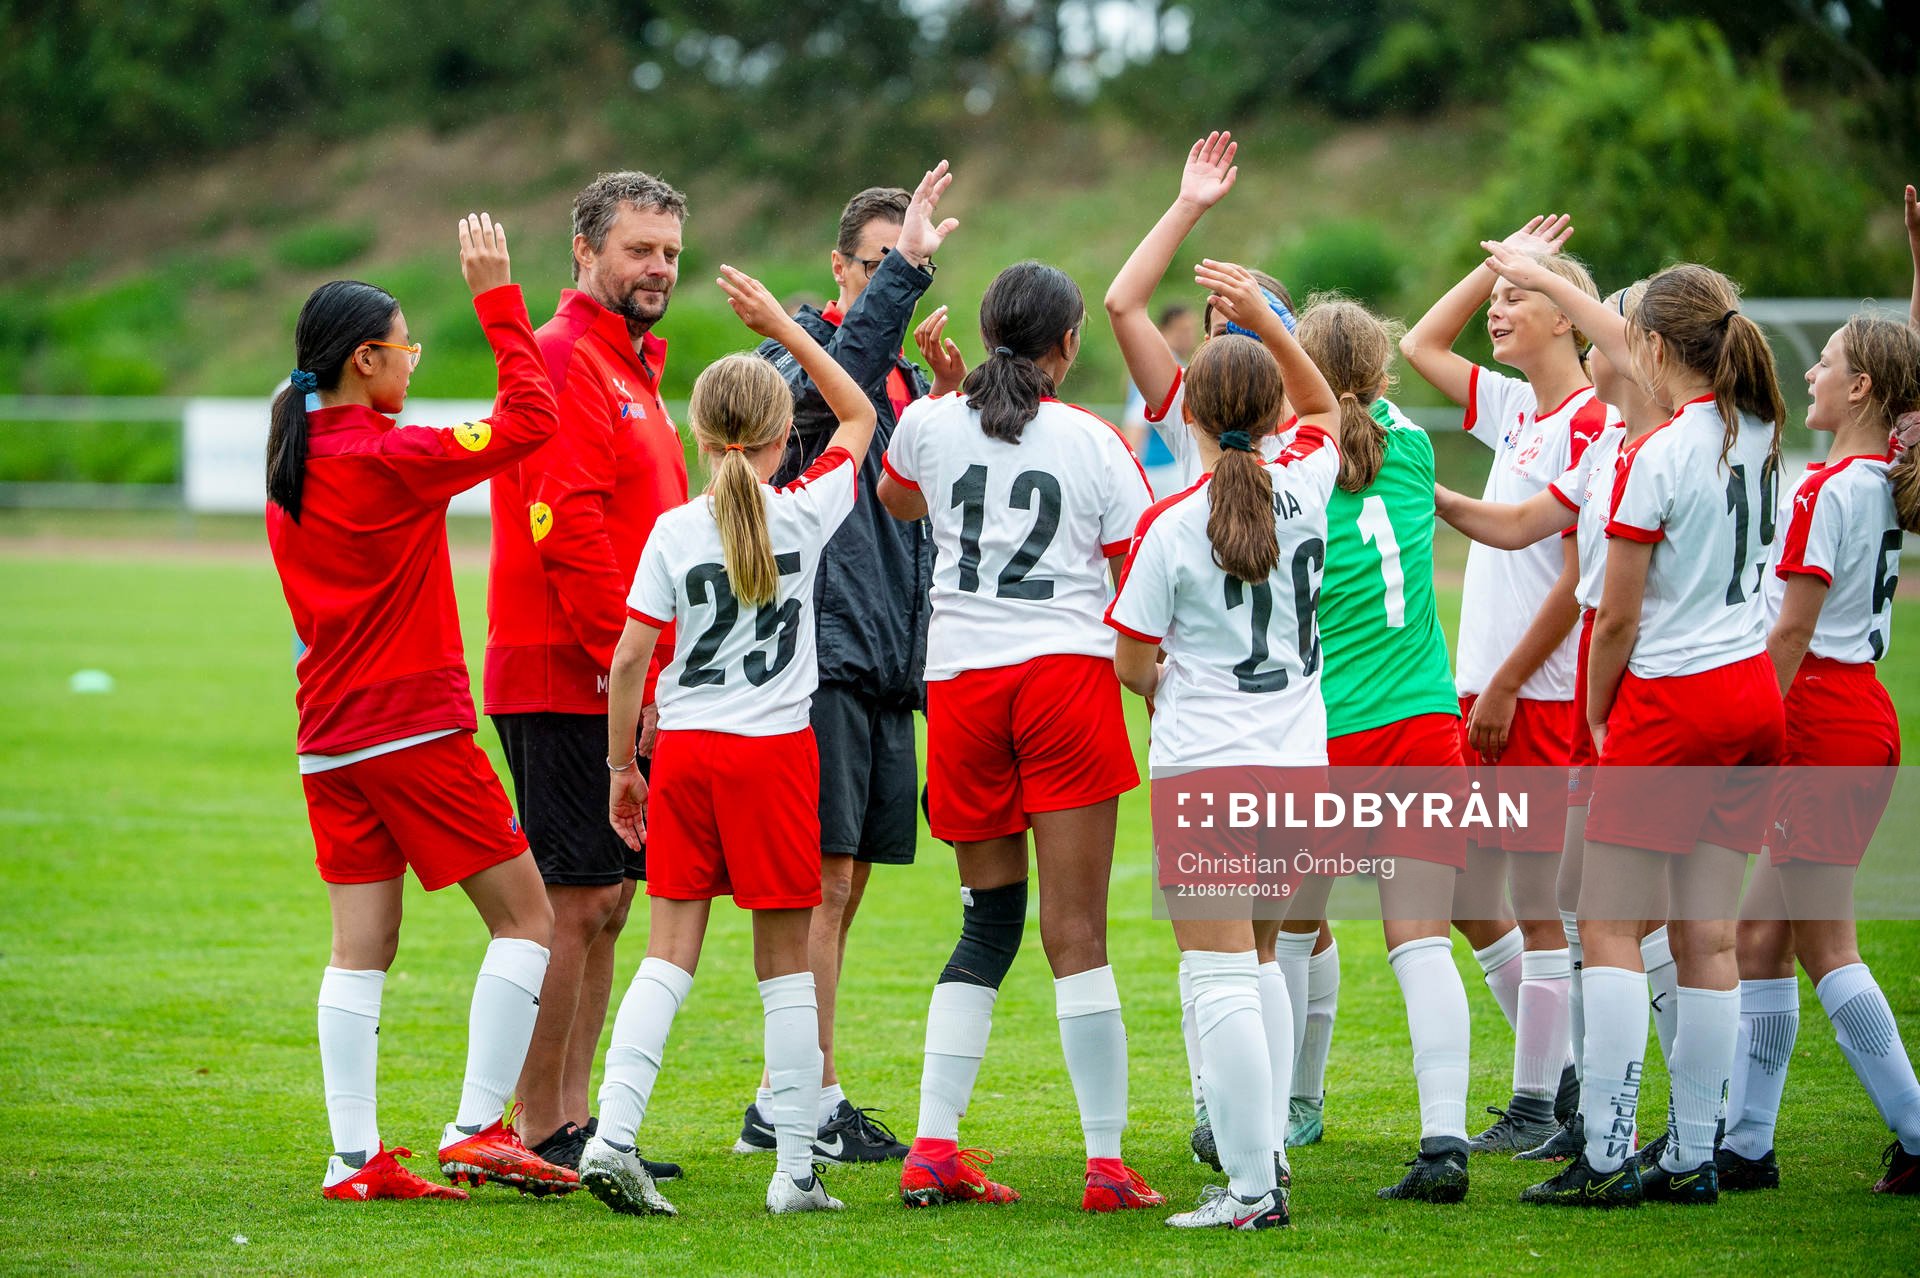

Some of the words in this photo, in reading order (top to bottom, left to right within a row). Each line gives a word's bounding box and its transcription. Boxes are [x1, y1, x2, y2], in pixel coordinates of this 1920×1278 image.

[951, 464, 1062, 600] 12
[1356, 495, 1405, 628] 1
[678, 551, 802, 687] 25
